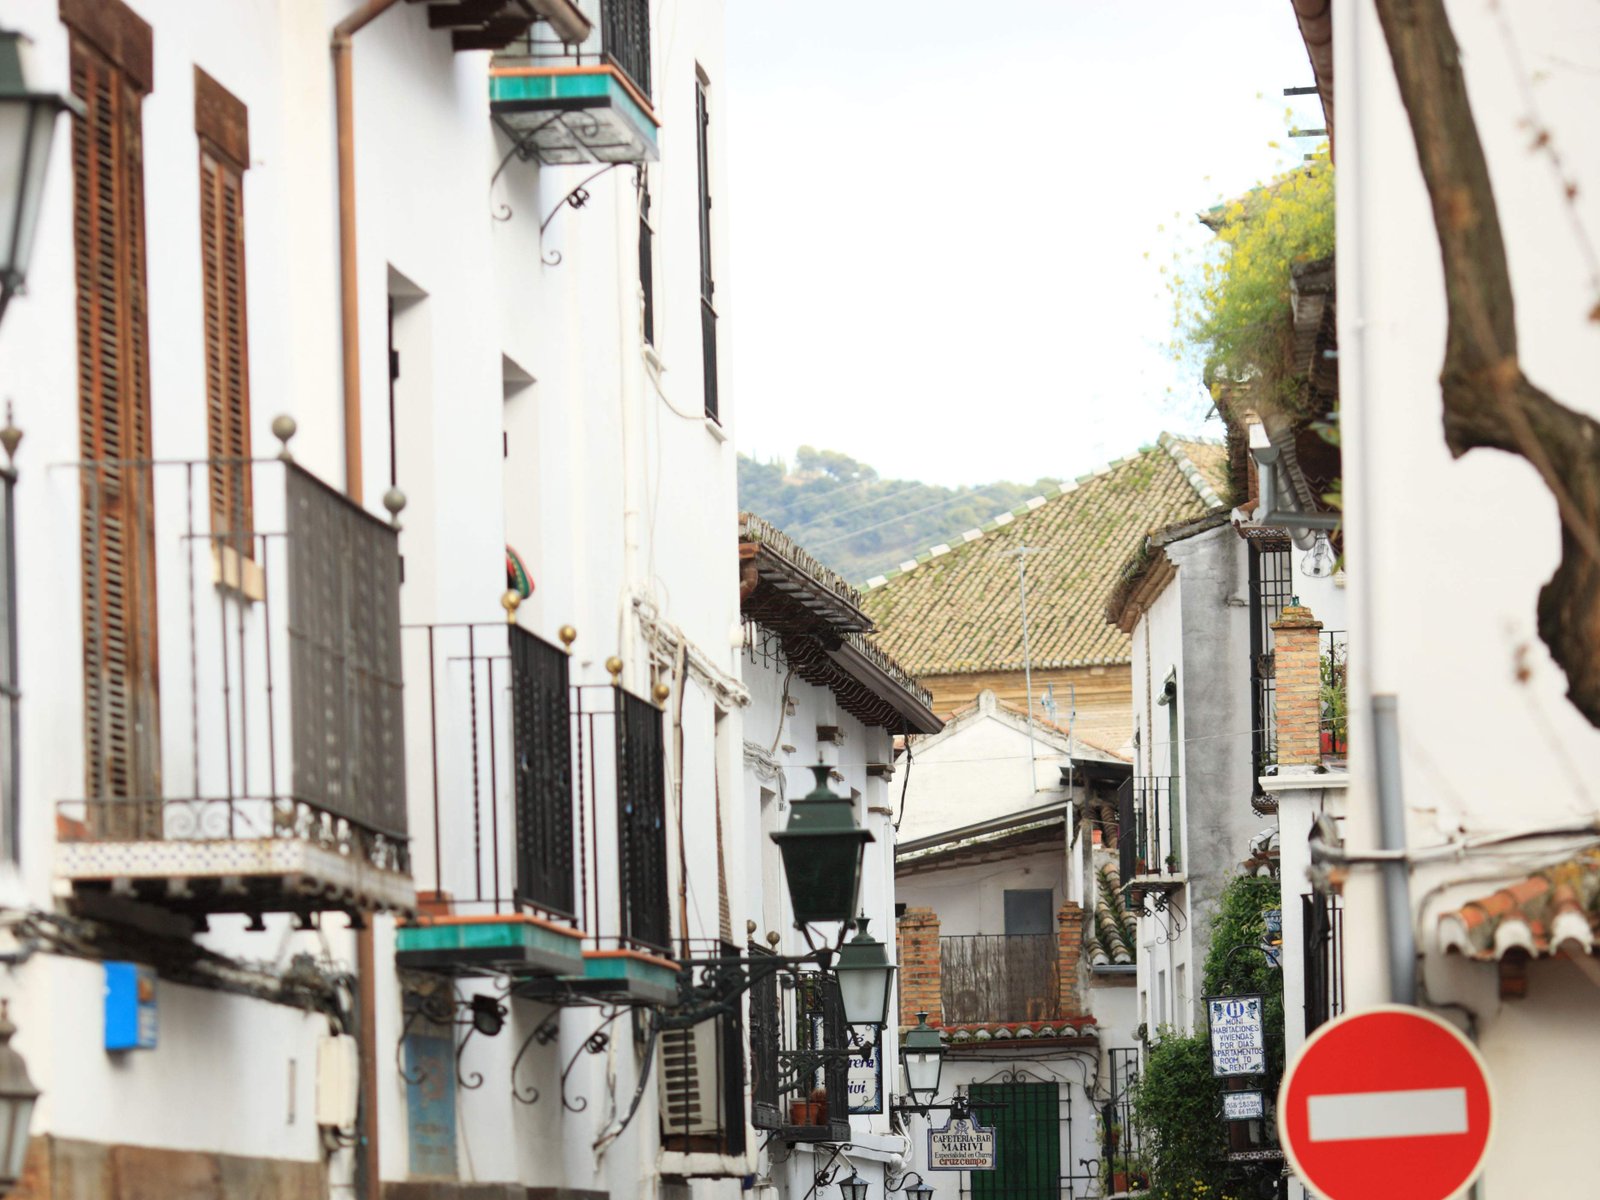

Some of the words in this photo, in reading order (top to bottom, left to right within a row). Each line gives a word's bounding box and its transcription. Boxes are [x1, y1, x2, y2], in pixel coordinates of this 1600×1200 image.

[1213, 1025, 1259, 1034] HABITACIONES
[1220, 1033, 1254, 1041] VIVIENDAS
[1213, 1048, 1264, 1057] APARTAMENTOS
[1220, 1057, 1239, 1065] ROOM
[1229, 1063, 1248, 1071] RENT
[941, 1143, 983, 1151] MARIVI
